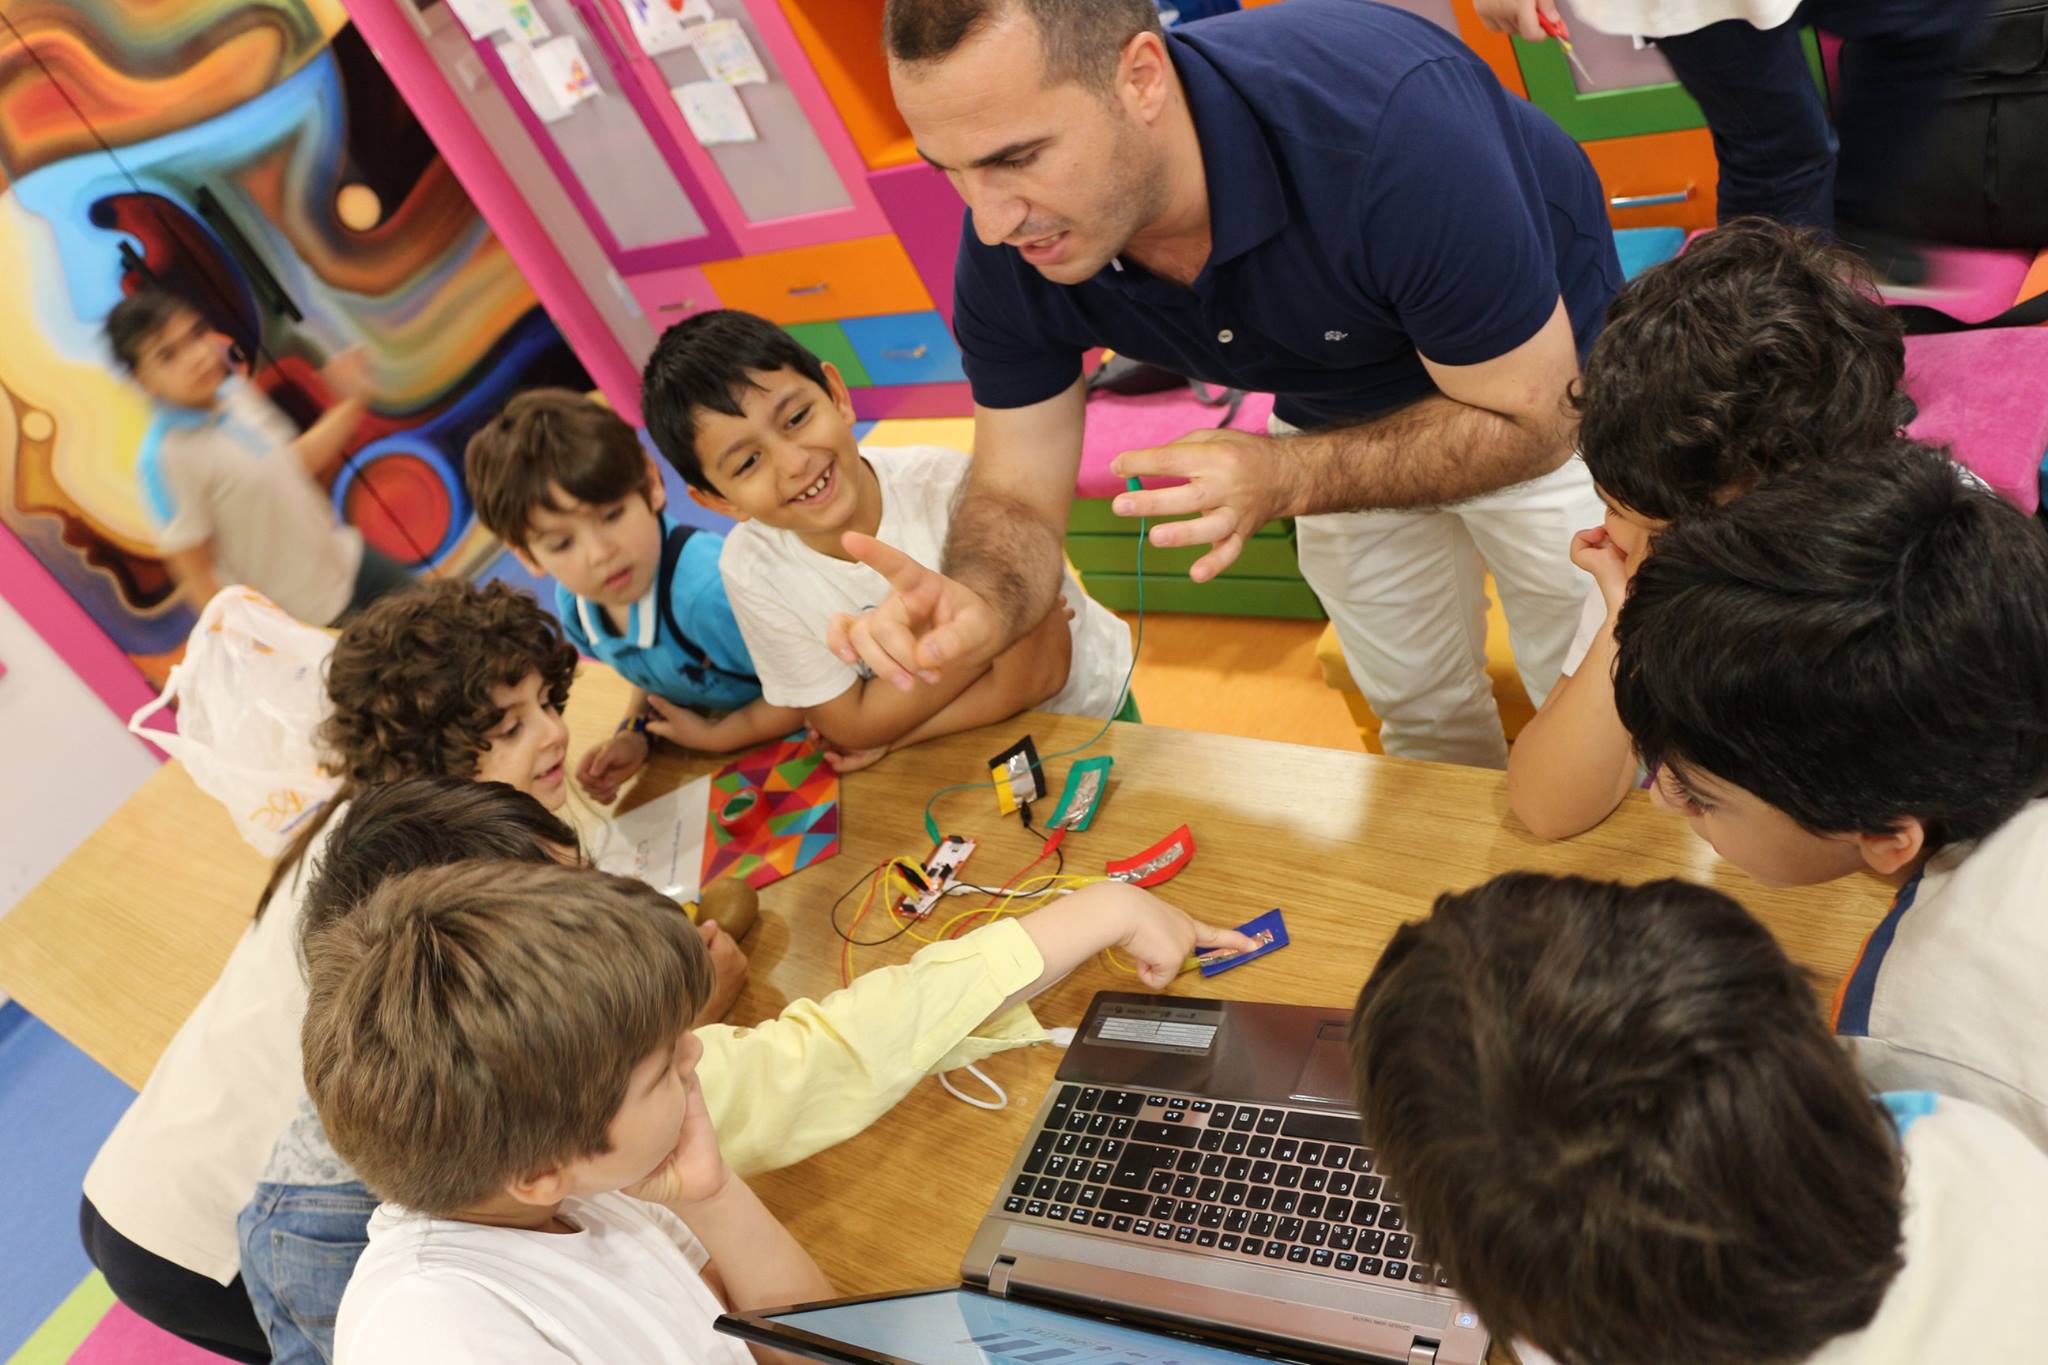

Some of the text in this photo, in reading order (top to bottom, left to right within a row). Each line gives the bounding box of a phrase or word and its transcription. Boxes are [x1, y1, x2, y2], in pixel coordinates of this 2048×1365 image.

[1283, 1150, 1291, 1158] M
[1337, 1157, 1344, 1165] B
[1362, 1160, 1368, 1168] V
[1240, 1168, 1244, 1176] L
[1262, 1172, 1269, 1180] K
[1289, 1176, 1295, 1184] J
[1314, 1180, 1321, 1188] H
[1340, 1183, 1347, 1191] G
[1368, 1187, 1375, 1195] F
[1209, 1190, 1216, 1198] P
[1233, 1194, 1240, 1202] O
[1284, 1201, 1292, 1209] U
[1311, 1206, 1316, 1214] Y
[1338, 1210, 1344, 1218] T
[1366, 1214, 1372, 1222] R
[1394, 1218, 1400, 1226] E
[1320, 1223, 1326, 1231] 6
